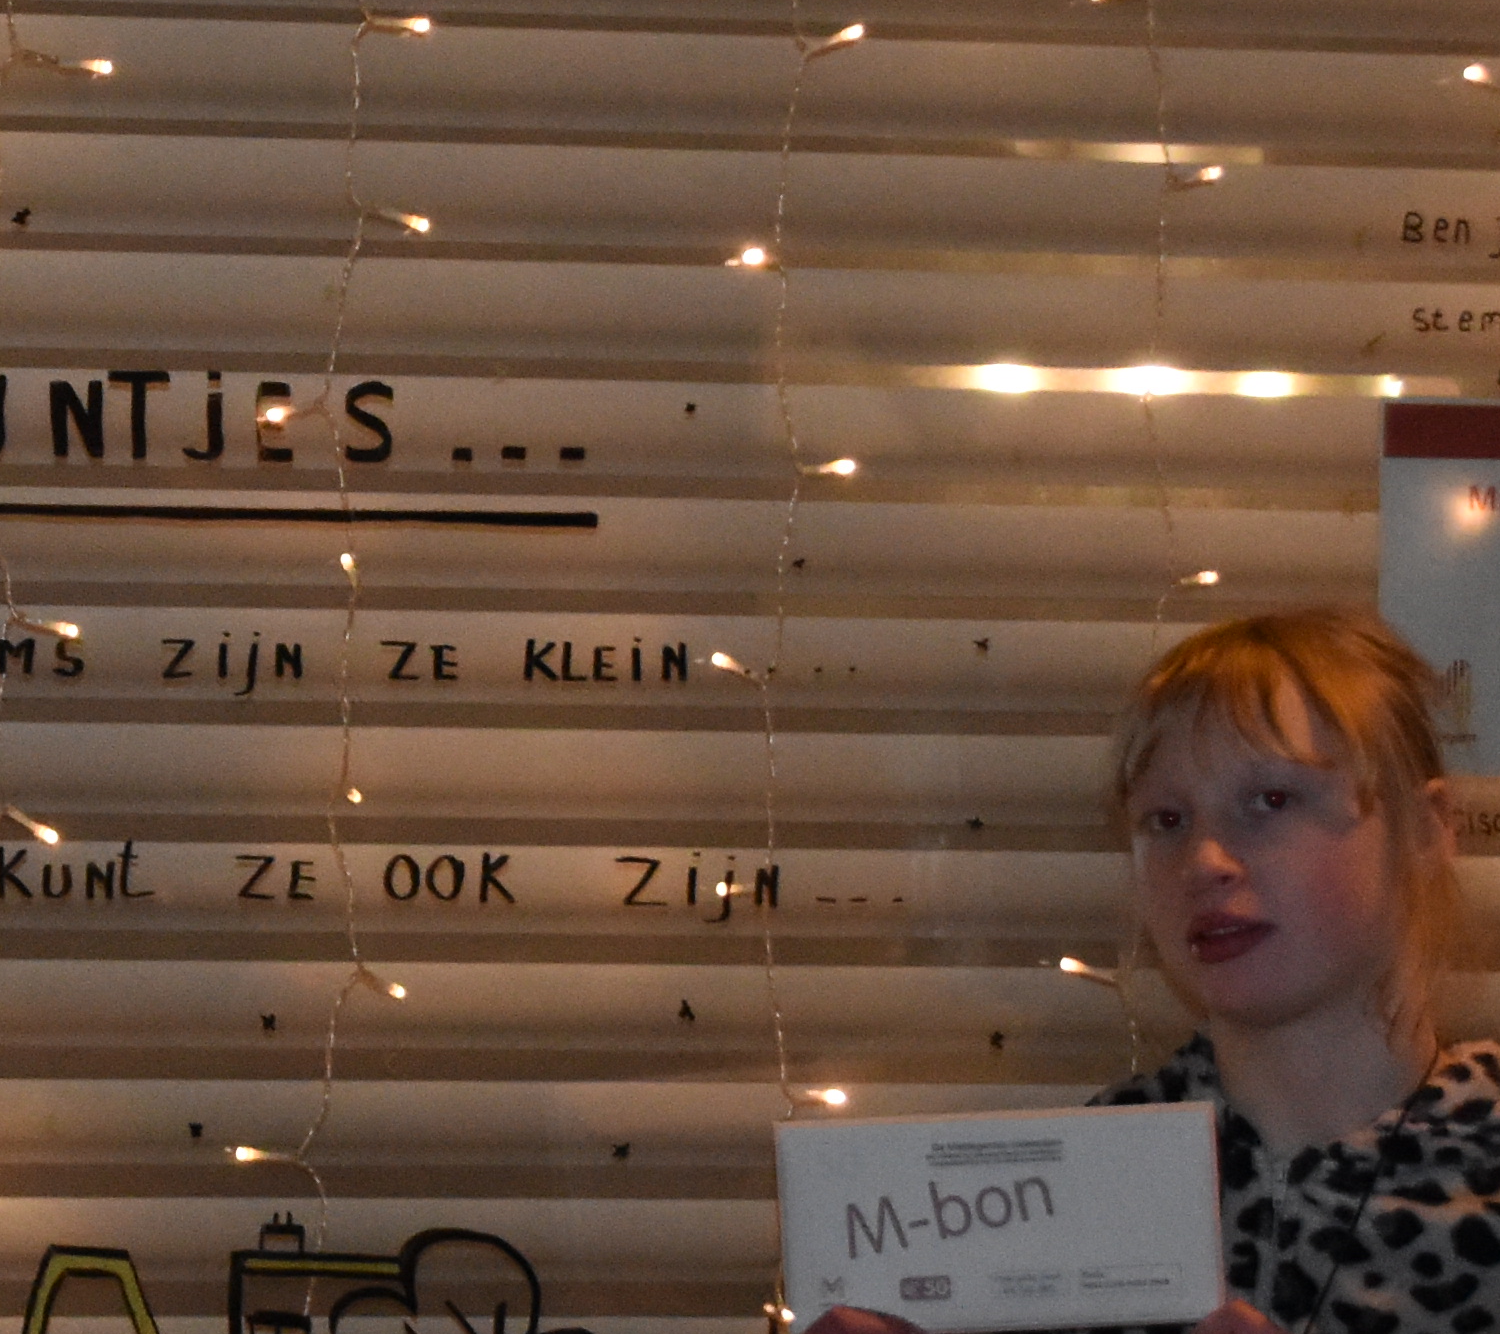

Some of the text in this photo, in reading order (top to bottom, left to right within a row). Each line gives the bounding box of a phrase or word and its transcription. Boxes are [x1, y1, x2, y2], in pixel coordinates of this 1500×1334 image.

[1402, 211, 1470, 244] Ben
[380, 639, 459, 681] ZE
[235, 854, 317, 900] ZE
[384, 852, 516, 904] OOK
[845, 1175, 1056, 1260] M-bon
